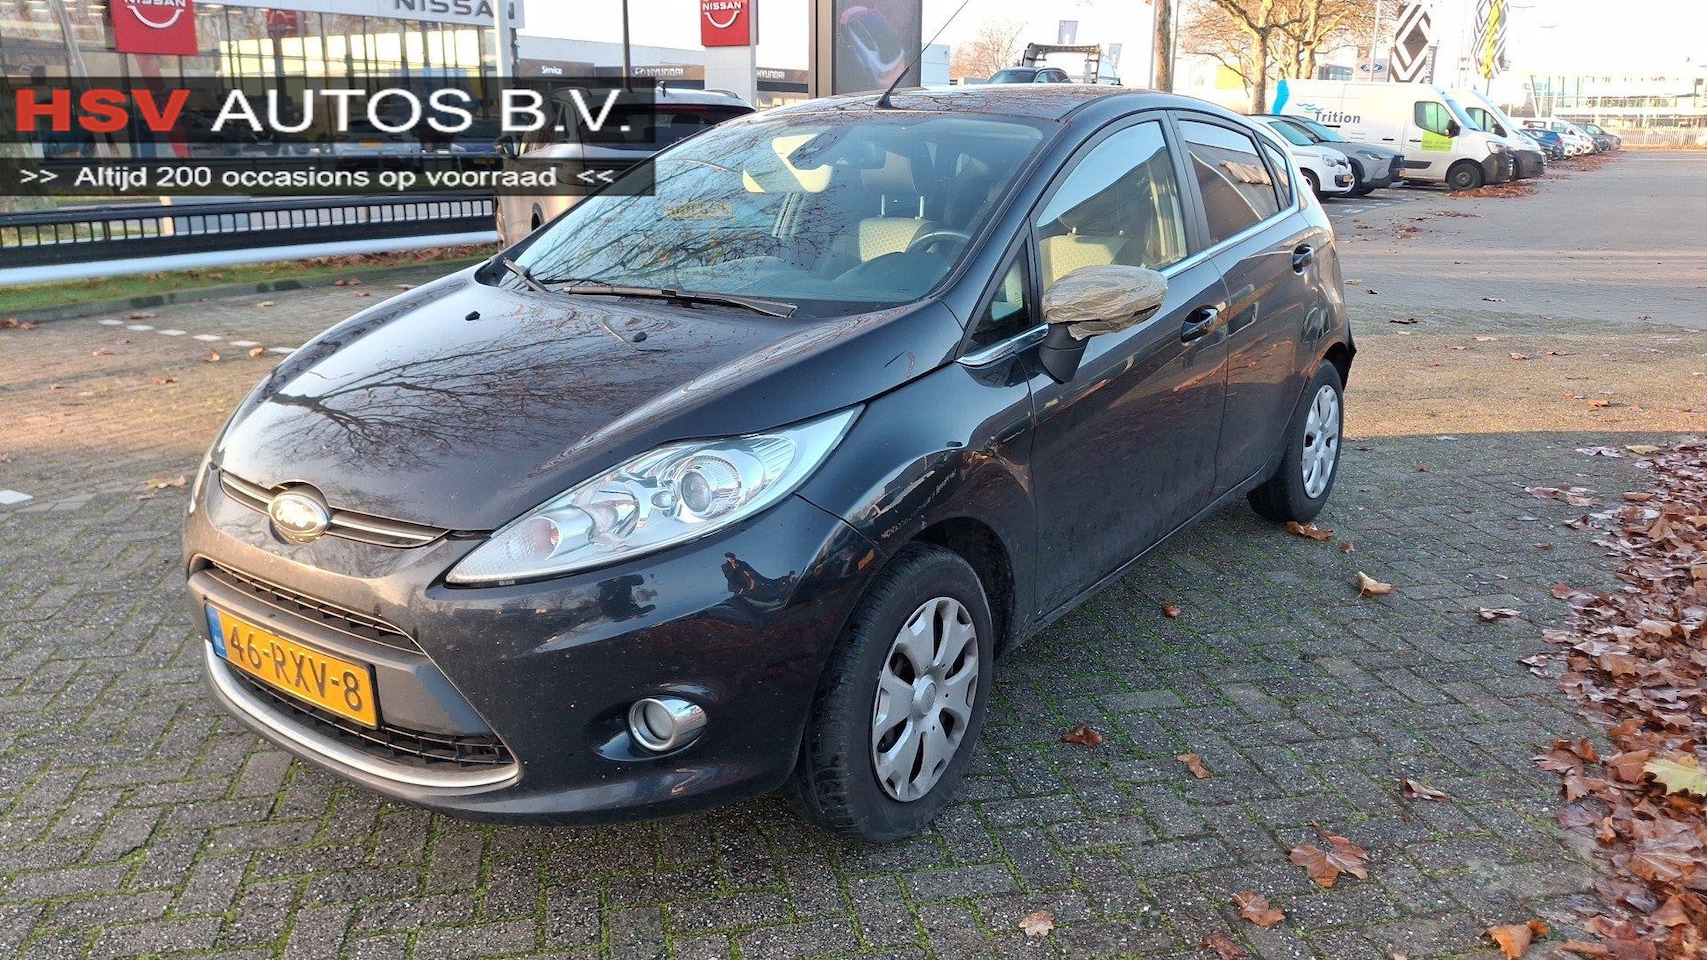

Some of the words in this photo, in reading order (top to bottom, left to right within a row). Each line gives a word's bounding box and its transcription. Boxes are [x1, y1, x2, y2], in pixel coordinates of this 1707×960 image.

[702, 2, 742, 11] NISSAN
[541, 65, 563, 75] Service
[646, 67, 684, 77] HYUNDAI
[756, 70, 785, 79] HYUNDAI
[1315, 111, 1361, 124] Trition
[230, 625, 363, 712] 46-RXV-8
